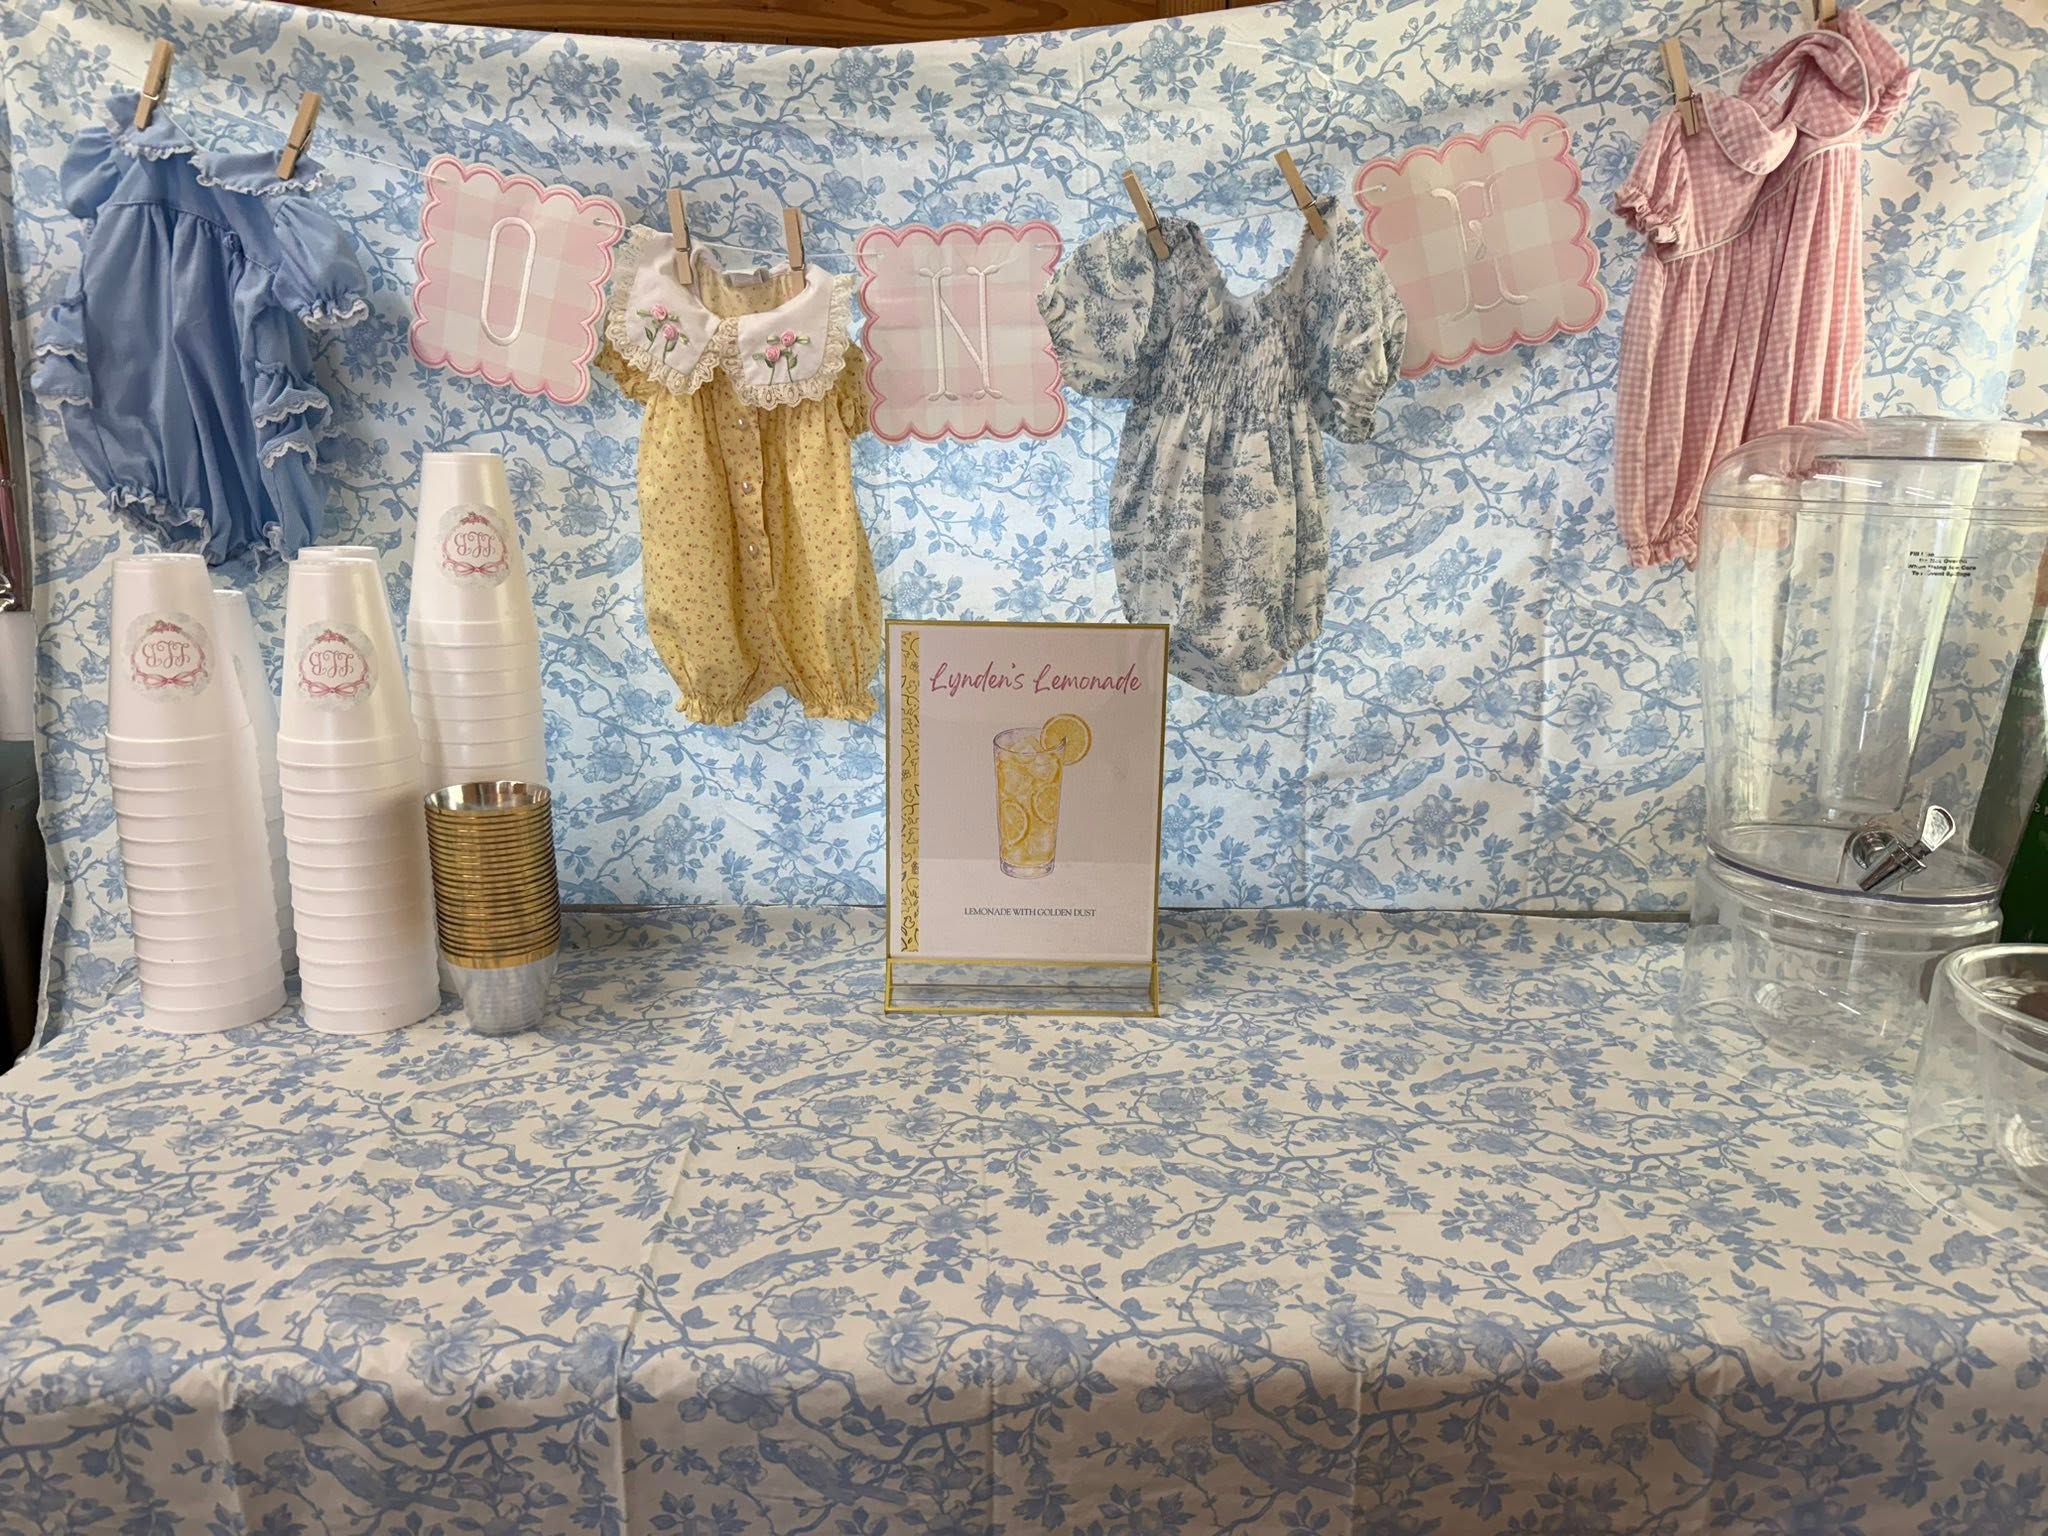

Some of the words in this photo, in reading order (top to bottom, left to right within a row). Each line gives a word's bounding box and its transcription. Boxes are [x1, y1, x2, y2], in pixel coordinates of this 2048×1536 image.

[918, 266, 1004, 400] N
[929, 661, 1025, 697] Lynden's
[1033, 663, 1142, 694] Lemonade
[964, 907, 1011, 916] LEMONADE
[1012, 907, 1036, 916] WITH
[1037, 908, 1072, 917] GOLDEN
[1073, 908, 1097, 917] DUST
